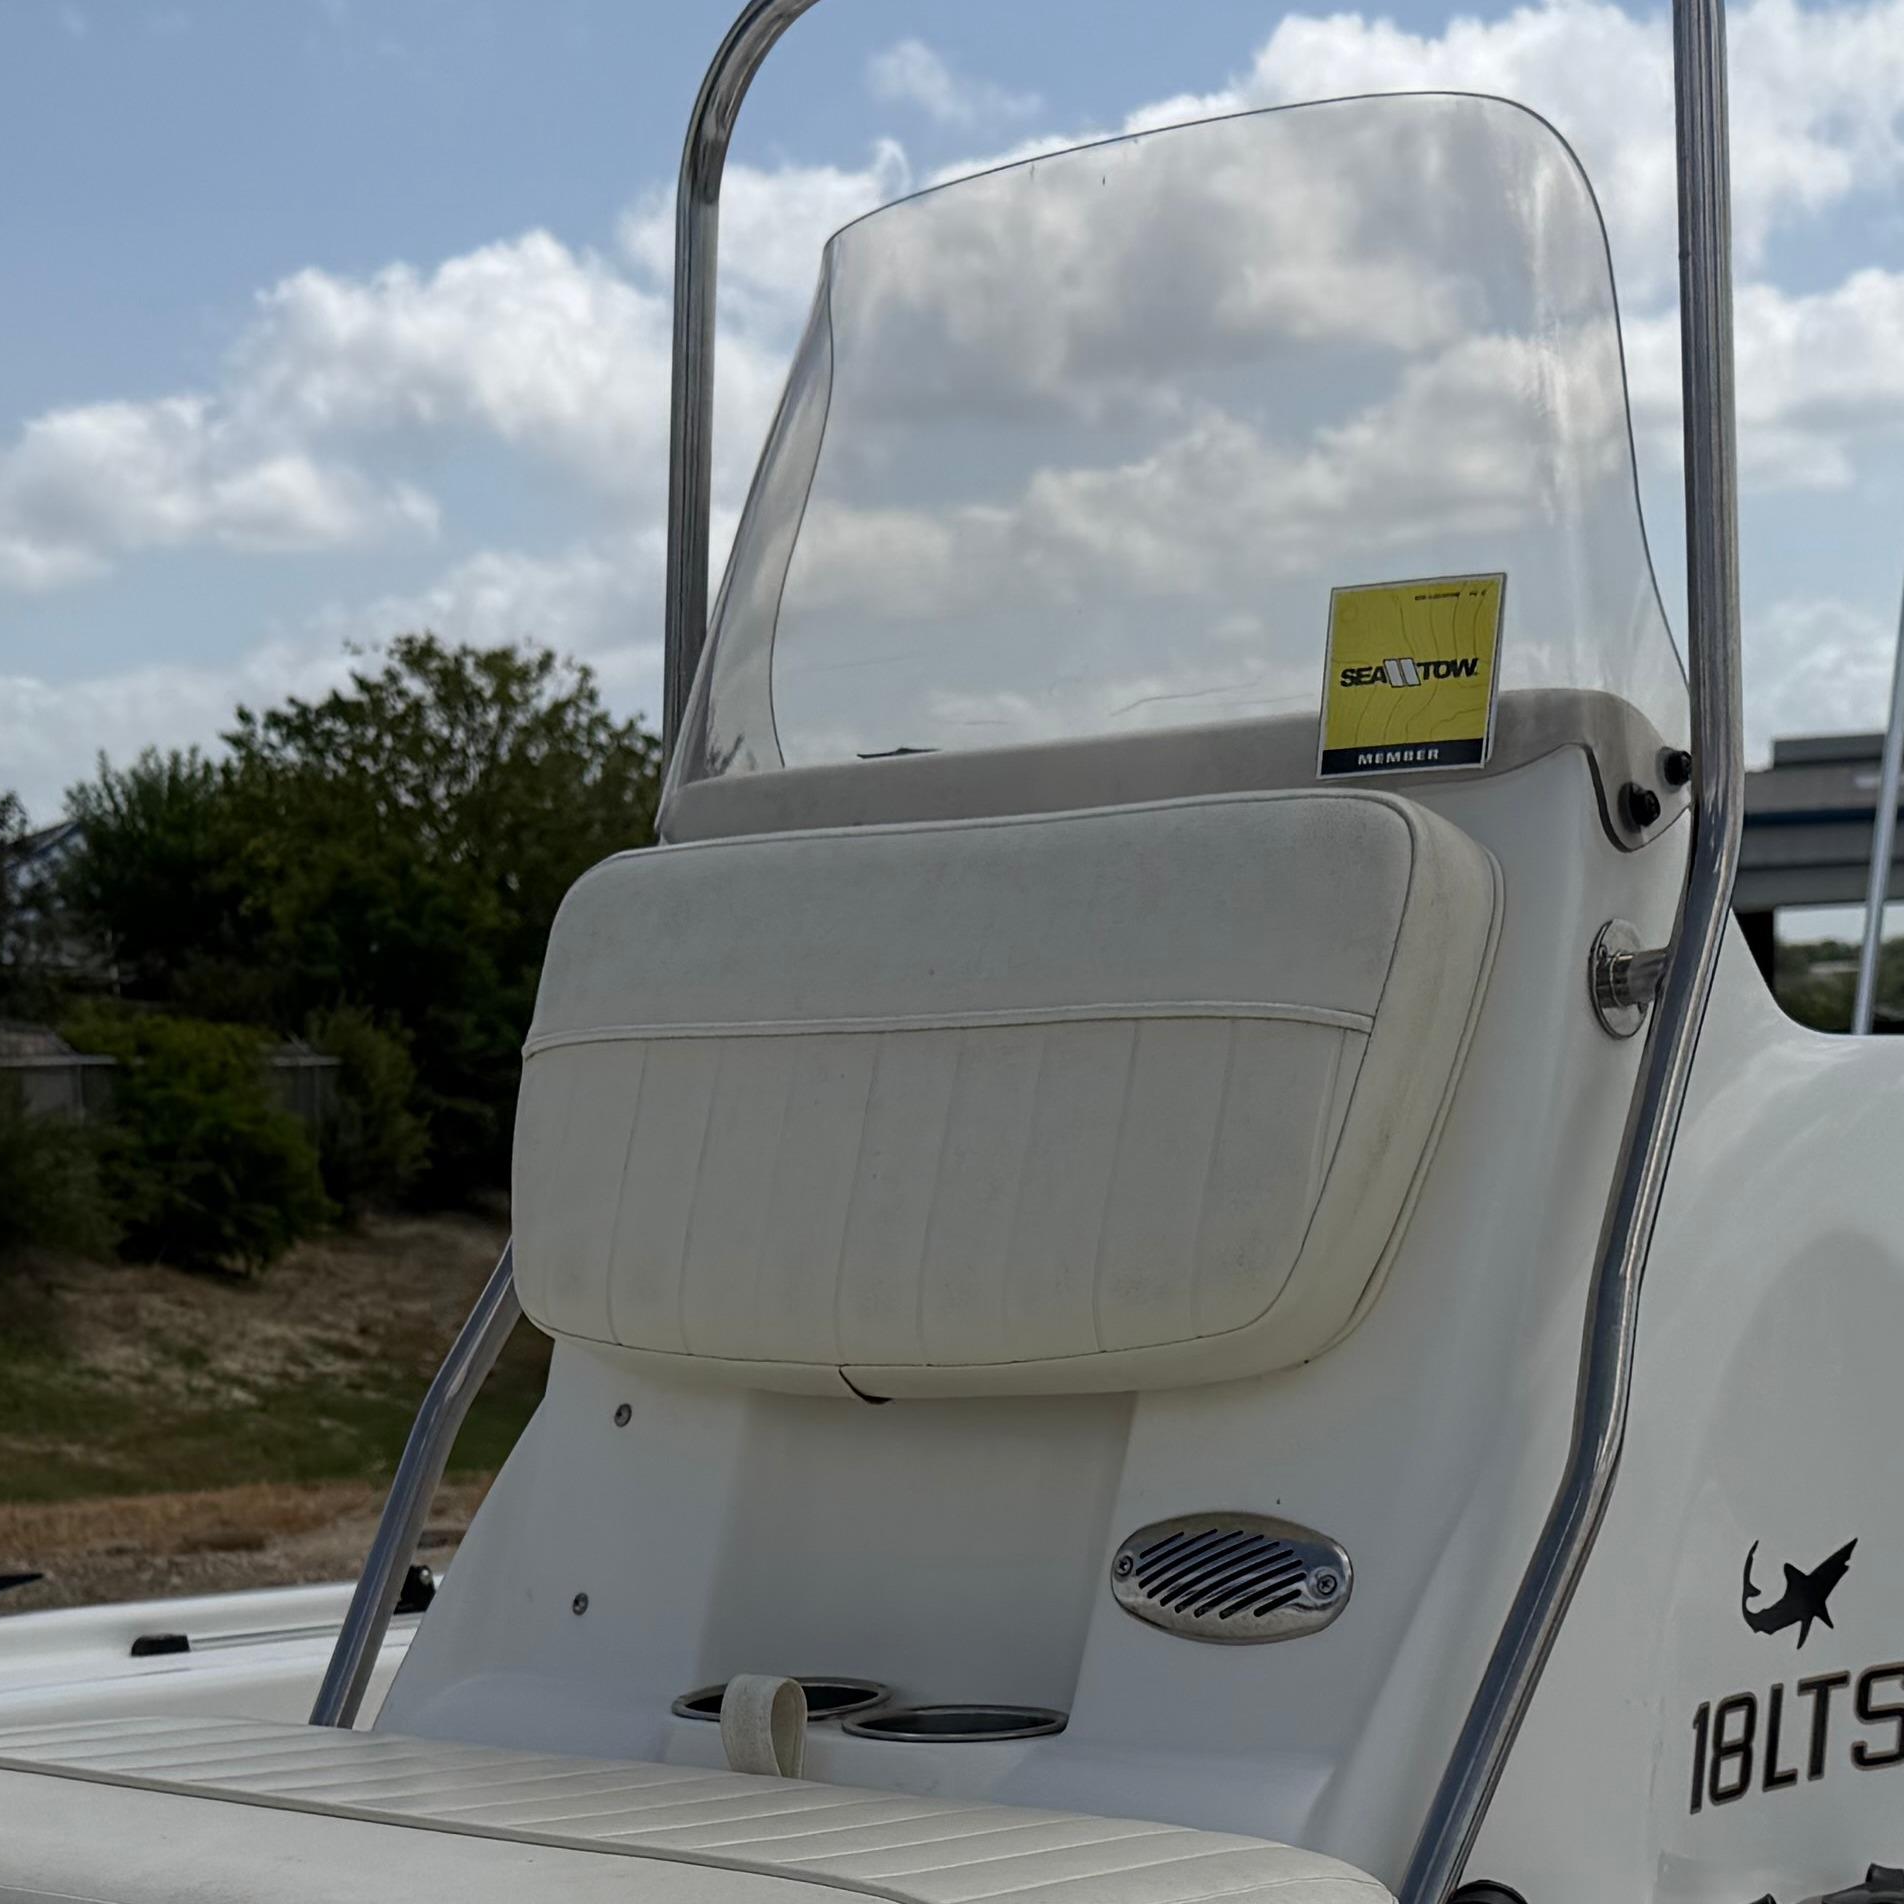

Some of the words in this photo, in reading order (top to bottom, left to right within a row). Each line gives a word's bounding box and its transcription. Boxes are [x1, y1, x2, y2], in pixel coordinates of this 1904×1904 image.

[1340, 665, 1387, 688] SEA
[1415, 657, 1478, 681] TOW
[1357, 748, 1440, 766] MEMBER
